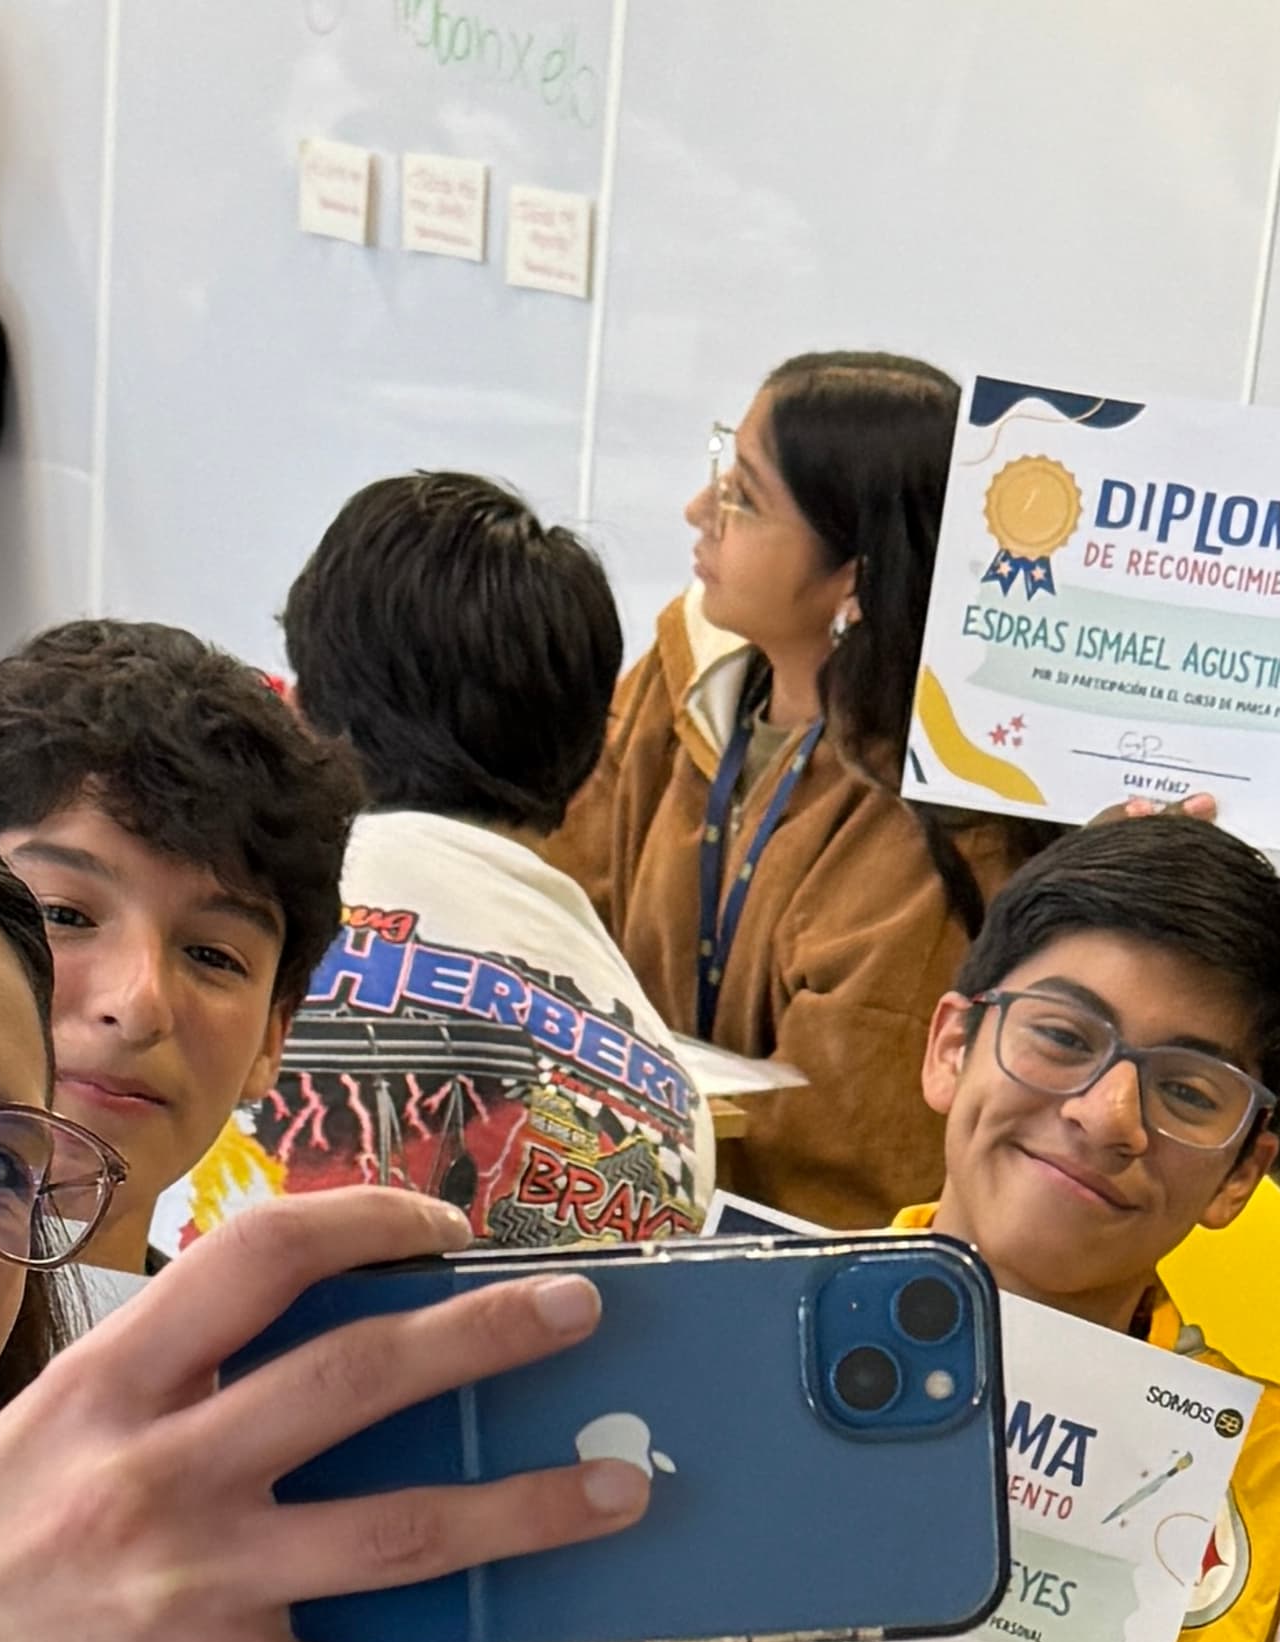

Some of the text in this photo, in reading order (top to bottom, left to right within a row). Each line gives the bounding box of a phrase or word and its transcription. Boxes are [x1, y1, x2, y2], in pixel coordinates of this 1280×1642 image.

[1083, 541, 1114, 570] DE
[962, 604, 1069, 654] ESDRAS
[1075, 625, 1170, 671] ISMAEL
[1032, 667, 1052, 681] POR
[1055, 671, 1069, 684] SU
[306, 925, 694, 1116] HERBERT
[1146, 1385, 1215, 1425] SOMOS
[1009, 1561, 1077, 1616] YES
